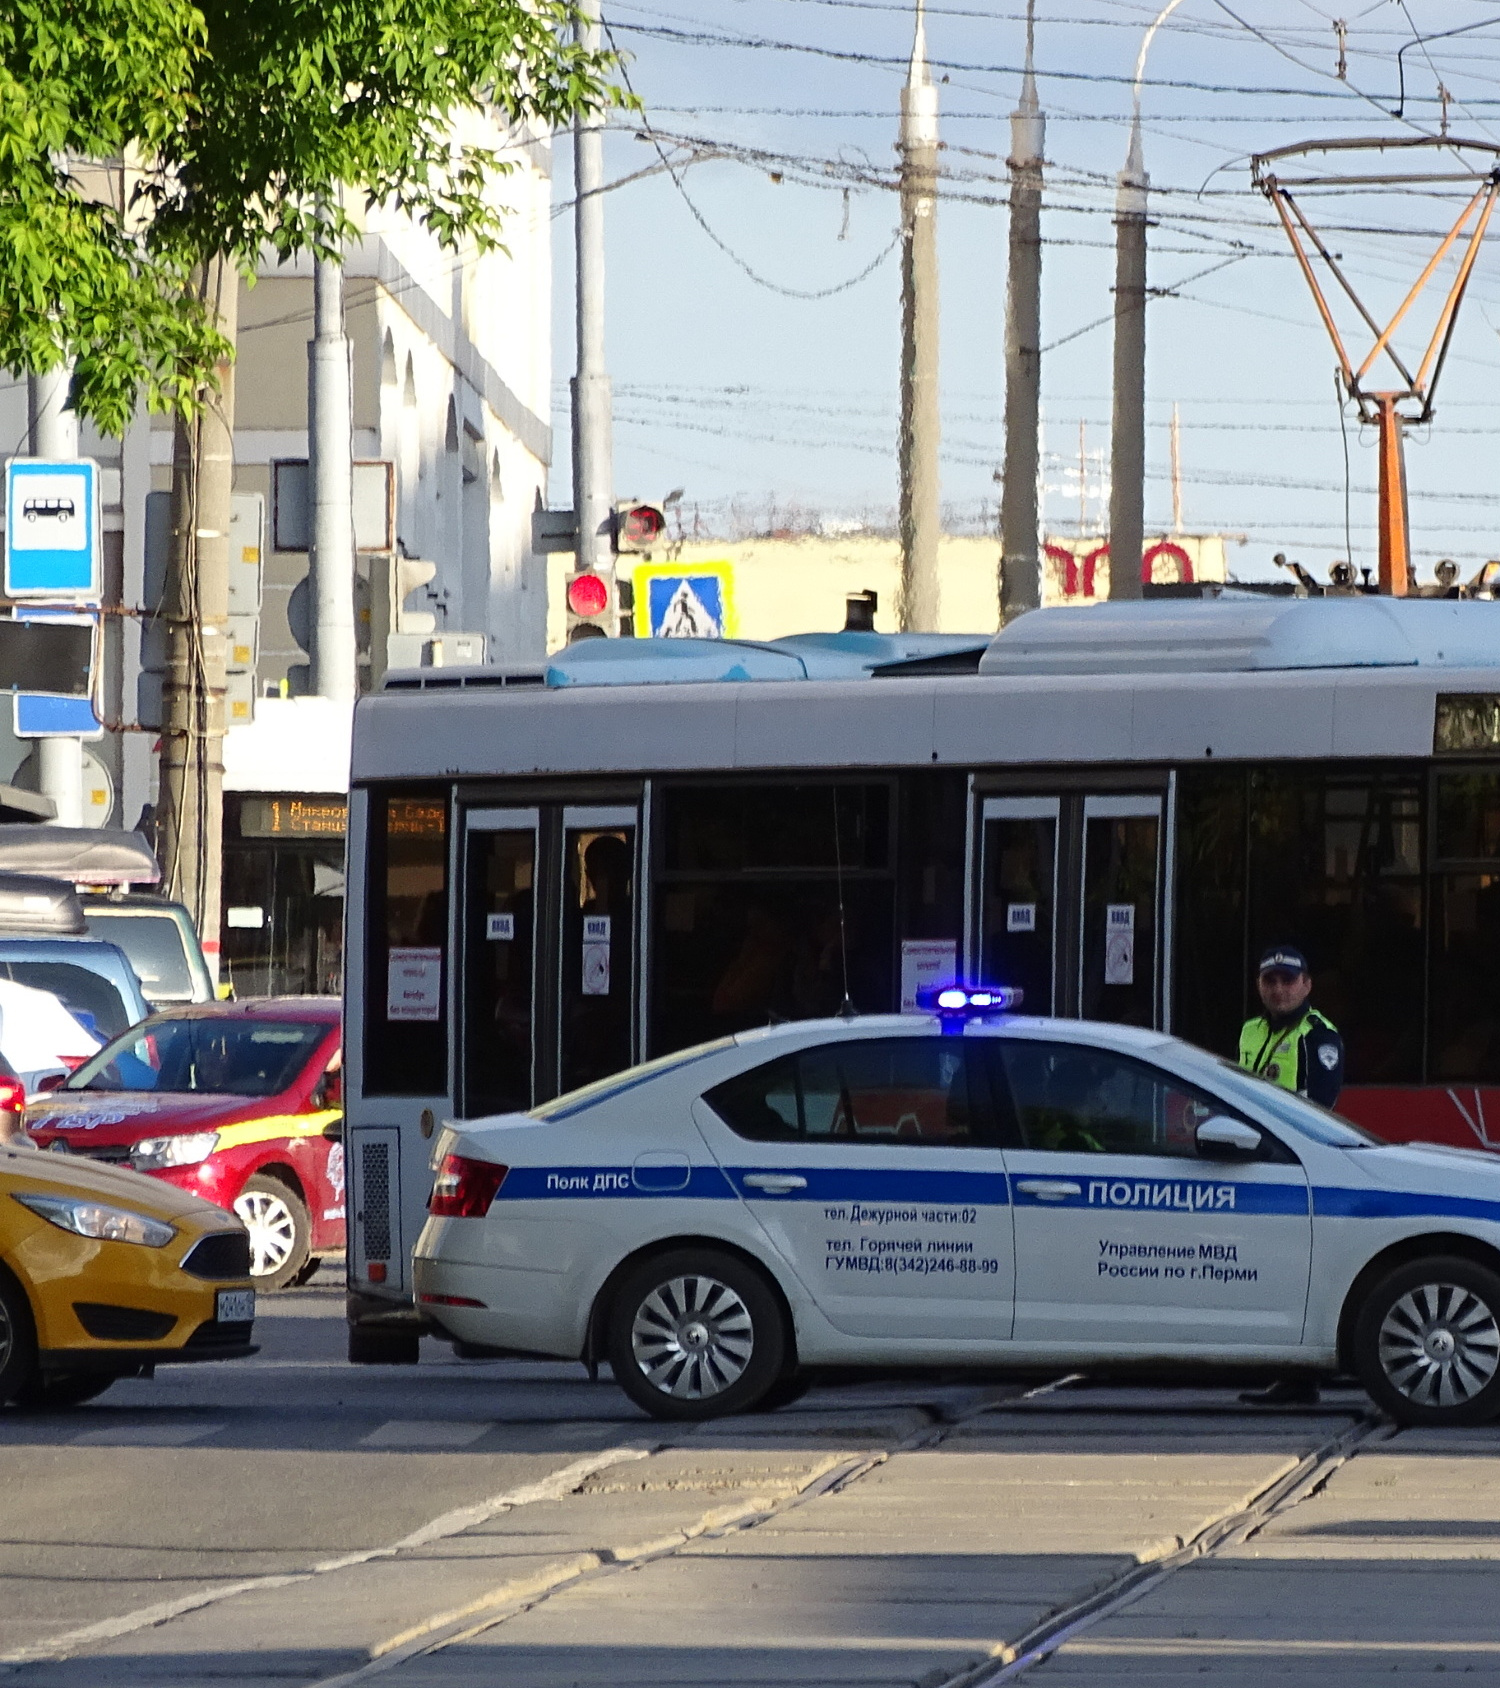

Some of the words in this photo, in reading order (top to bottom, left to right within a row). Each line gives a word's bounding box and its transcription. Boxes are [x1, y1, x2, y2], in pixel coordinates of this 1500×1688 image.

[547, 1173, 589, 1190] Полк
[593, 1173, 630, 1192] ДПС
[1088, 1181, 1236, 1213] ПОЛИЦИЯ
[826, 1239, 855, 1252] тел.
[860, 1236, 922, 1255] Горячей
[927, 1243, 973, 1253] линии
[1099, 1240, 1195, 1260] Управление
[1199, 1244, 1237, 1262] МВД
[1098, 1262, 1159, 1280] России
[1164, 1267, 1185, 1279] по
